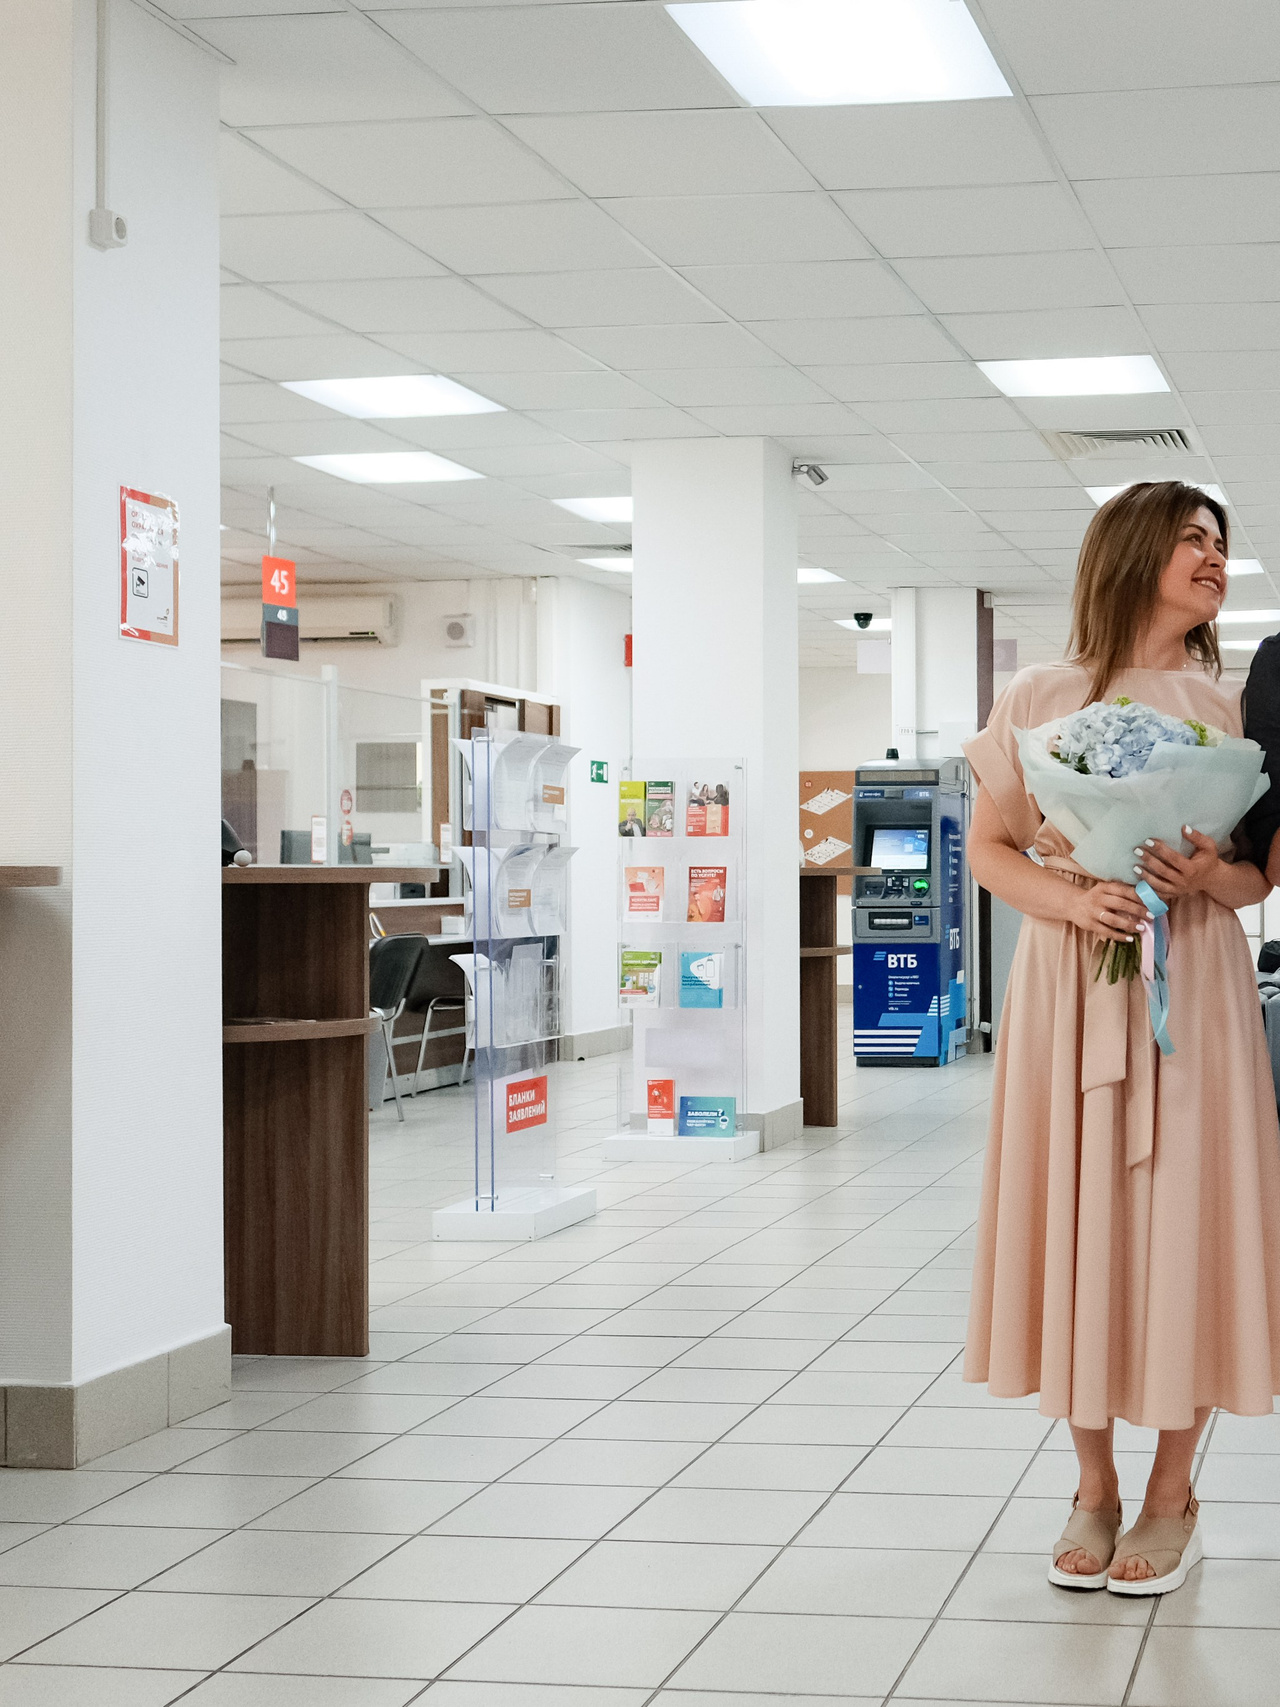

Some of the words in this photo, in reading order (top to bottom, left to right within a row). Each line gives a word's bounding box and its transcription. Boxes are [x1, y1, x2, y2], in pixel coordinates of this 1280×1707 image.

[270, 569, 289, 595] 45
[949, 927, 960, 950] ВТБ
[887, 953, 918, 969] ВТБ
[508, 1089, 536, 1107] БЛАНКИ
[508, 1099, 546, 1123] ЗАЯВЛЕНИЙ
